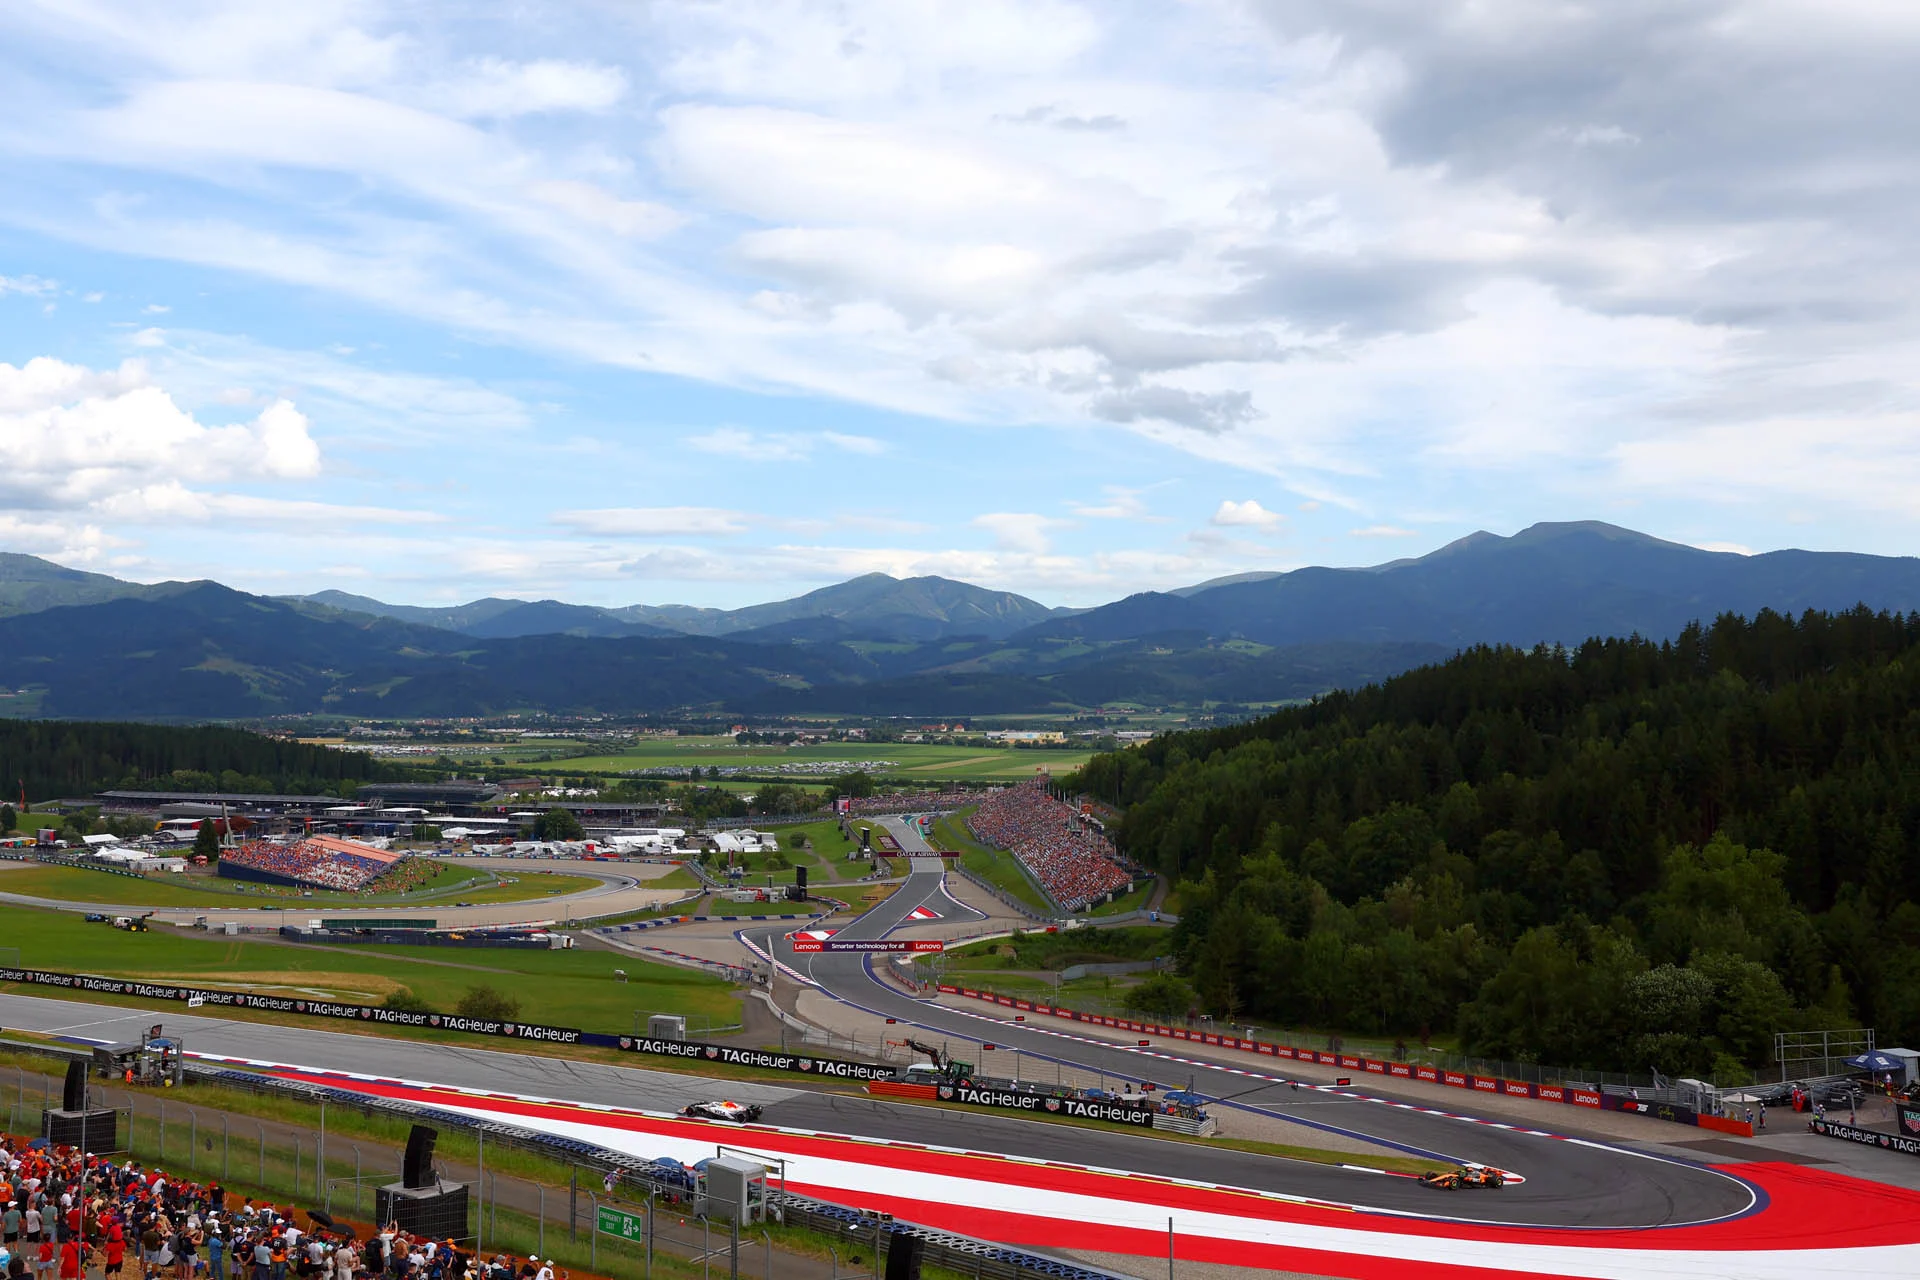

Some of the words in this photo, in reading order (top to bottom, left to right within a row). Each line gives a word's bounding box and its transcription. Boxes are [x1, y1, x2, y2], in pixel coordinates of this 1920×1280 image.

[795, 942, 820, 950] Lenovo
[856, 942, 888, 950] technology
[916, 942, 941, 950] Lenovo
[0, 969, 24, 980] GHeuer
[35, 972, 72, 986] TAGHeuer
[83, 978, 123, 992] TAGHeuer
[135, 985, 177, 998] TAGHeuer
[189, 990, 233, 1004] TAGHeuer
[247, 996, 293, 1010] TAGHeuer
[308, 1002, 358, 1018] TAGHeuer
[373, 1009, 426, 1025] TAGHeuer
[443, 1016, 500, 1033] TAGHeuer
[518, 1025, 579, 1042] TAGHeuer
[634, 1039, 701, 1057] TAGHeuer
[722, 1048, 794, 1069] TAGHeuer
[1342, 1058, 1359, 1067] Lenovo
[1367, 1063, 1383, 1071] Lenovo
[1391, 1066, 1409, 1075] Lenovo
[1418, 1069, 1435, 1079] Lenovo
[1446, 1074, 1464, 1084] Lenovo
[1475, 1080, 1495, 1089] Lenovo
[1507, 1084, 1528, 1094] Lenovo
[958, 1088, 1040, 1109] TAGHeuer
[1540, 1089, 1562, 1099] Lenovo
[1575, 1093, 1599, 1104] Lenovo
[1065, 1101, 1150, 1123] TAGHeuer
[1826, 1124, 1878, 1144] TAGHeuer
[1891, 1138, 1920, 1153] TAGH
